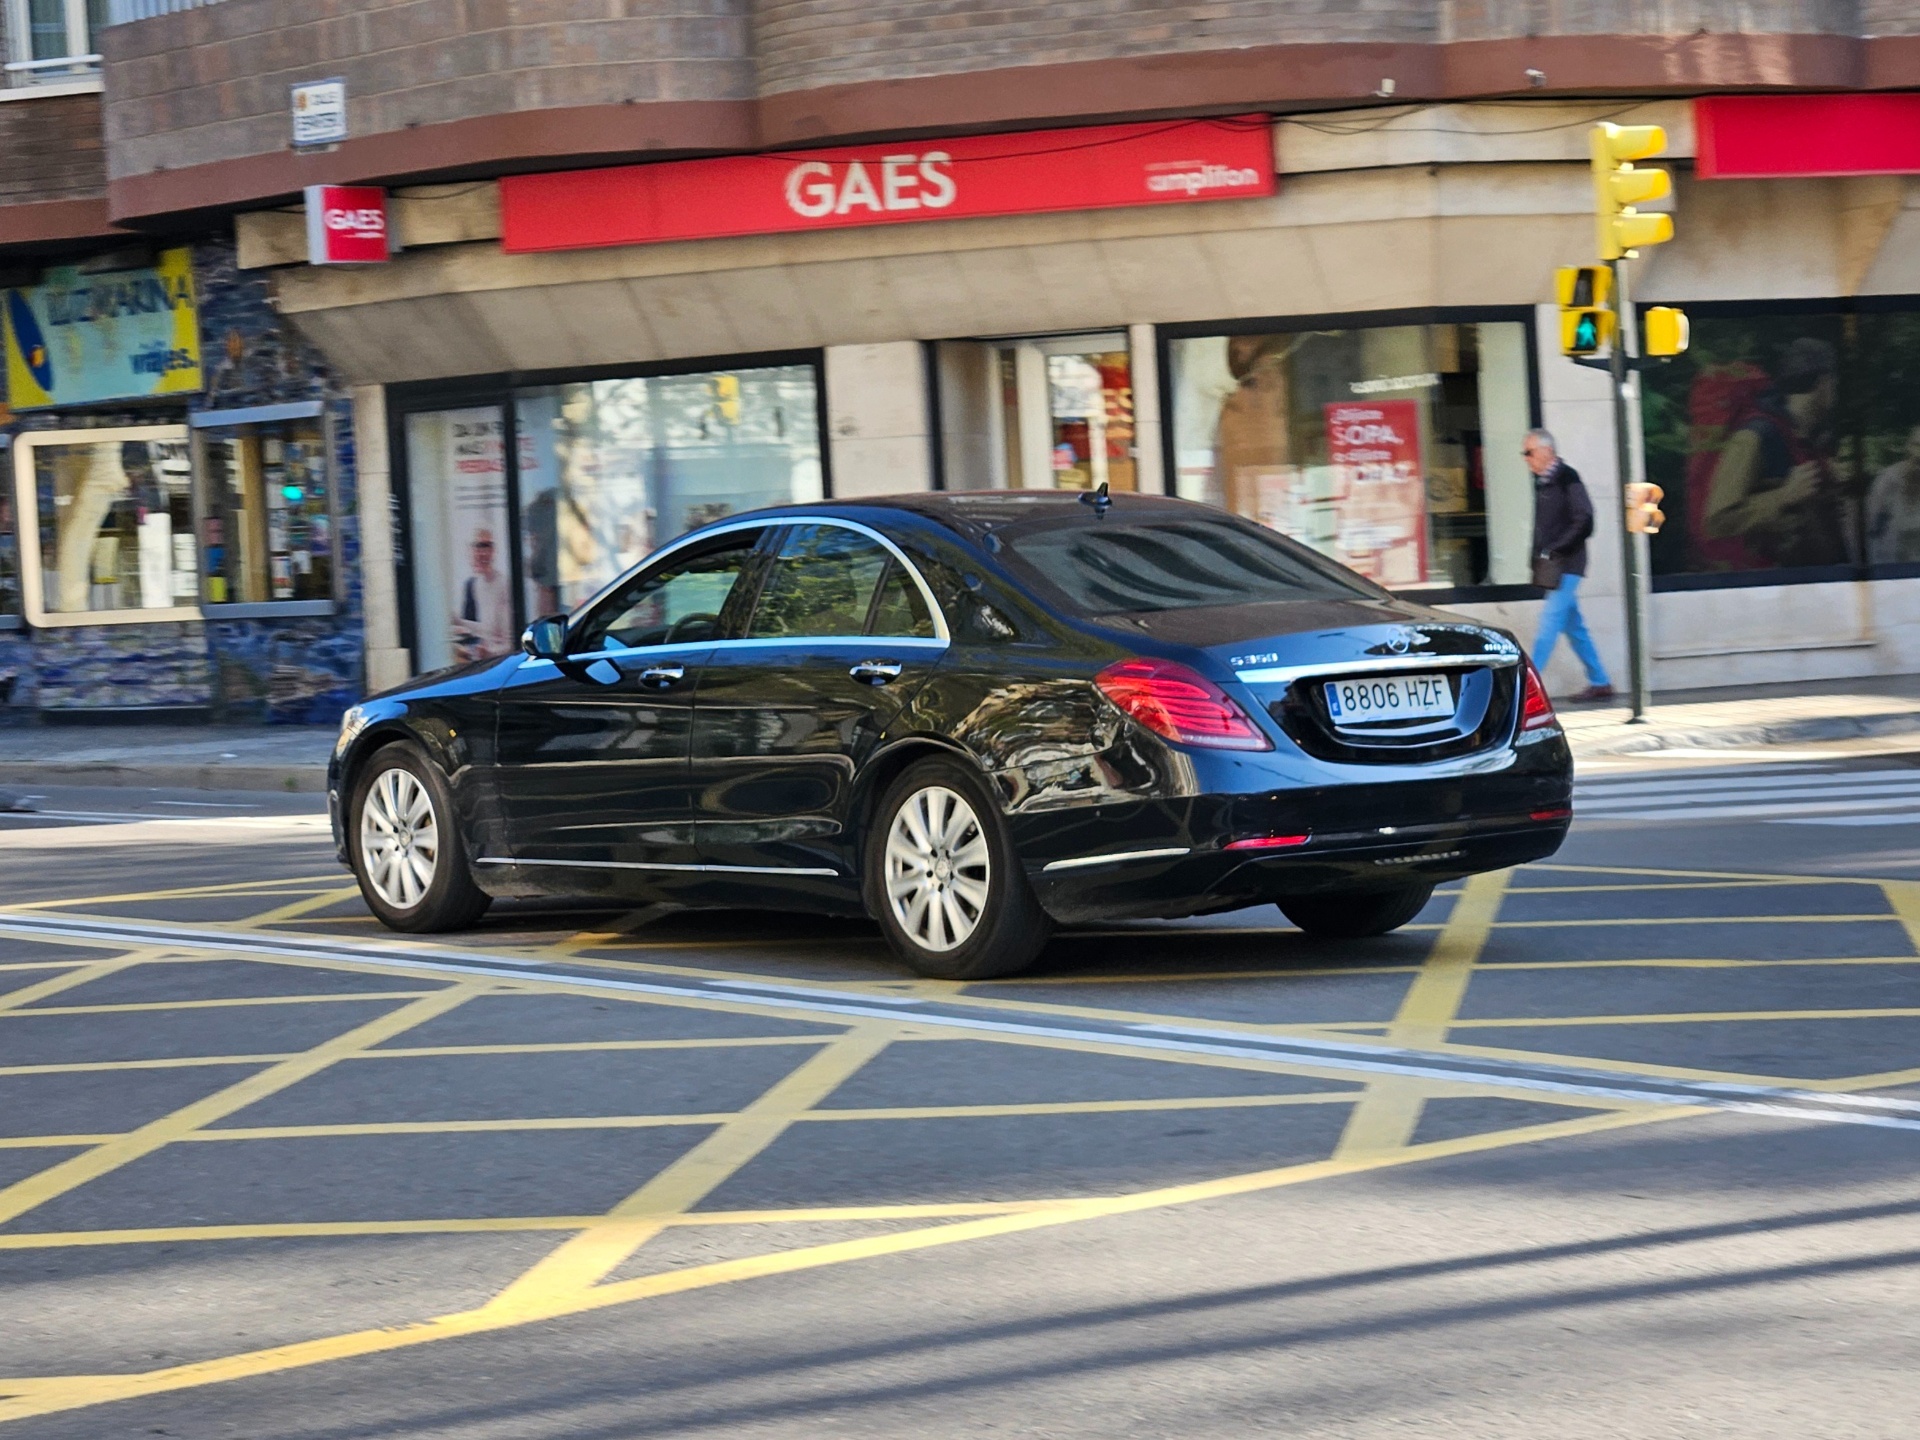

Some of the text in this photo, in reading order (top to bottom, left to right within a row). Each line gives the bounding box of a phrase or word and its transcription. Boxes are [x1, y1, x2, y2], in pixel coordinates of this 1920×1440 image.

[785, 151, 957, 217] GAES
[324, 208, 385, 230] GAES
[1342, 679, 1443, 712] 8806 HZF
